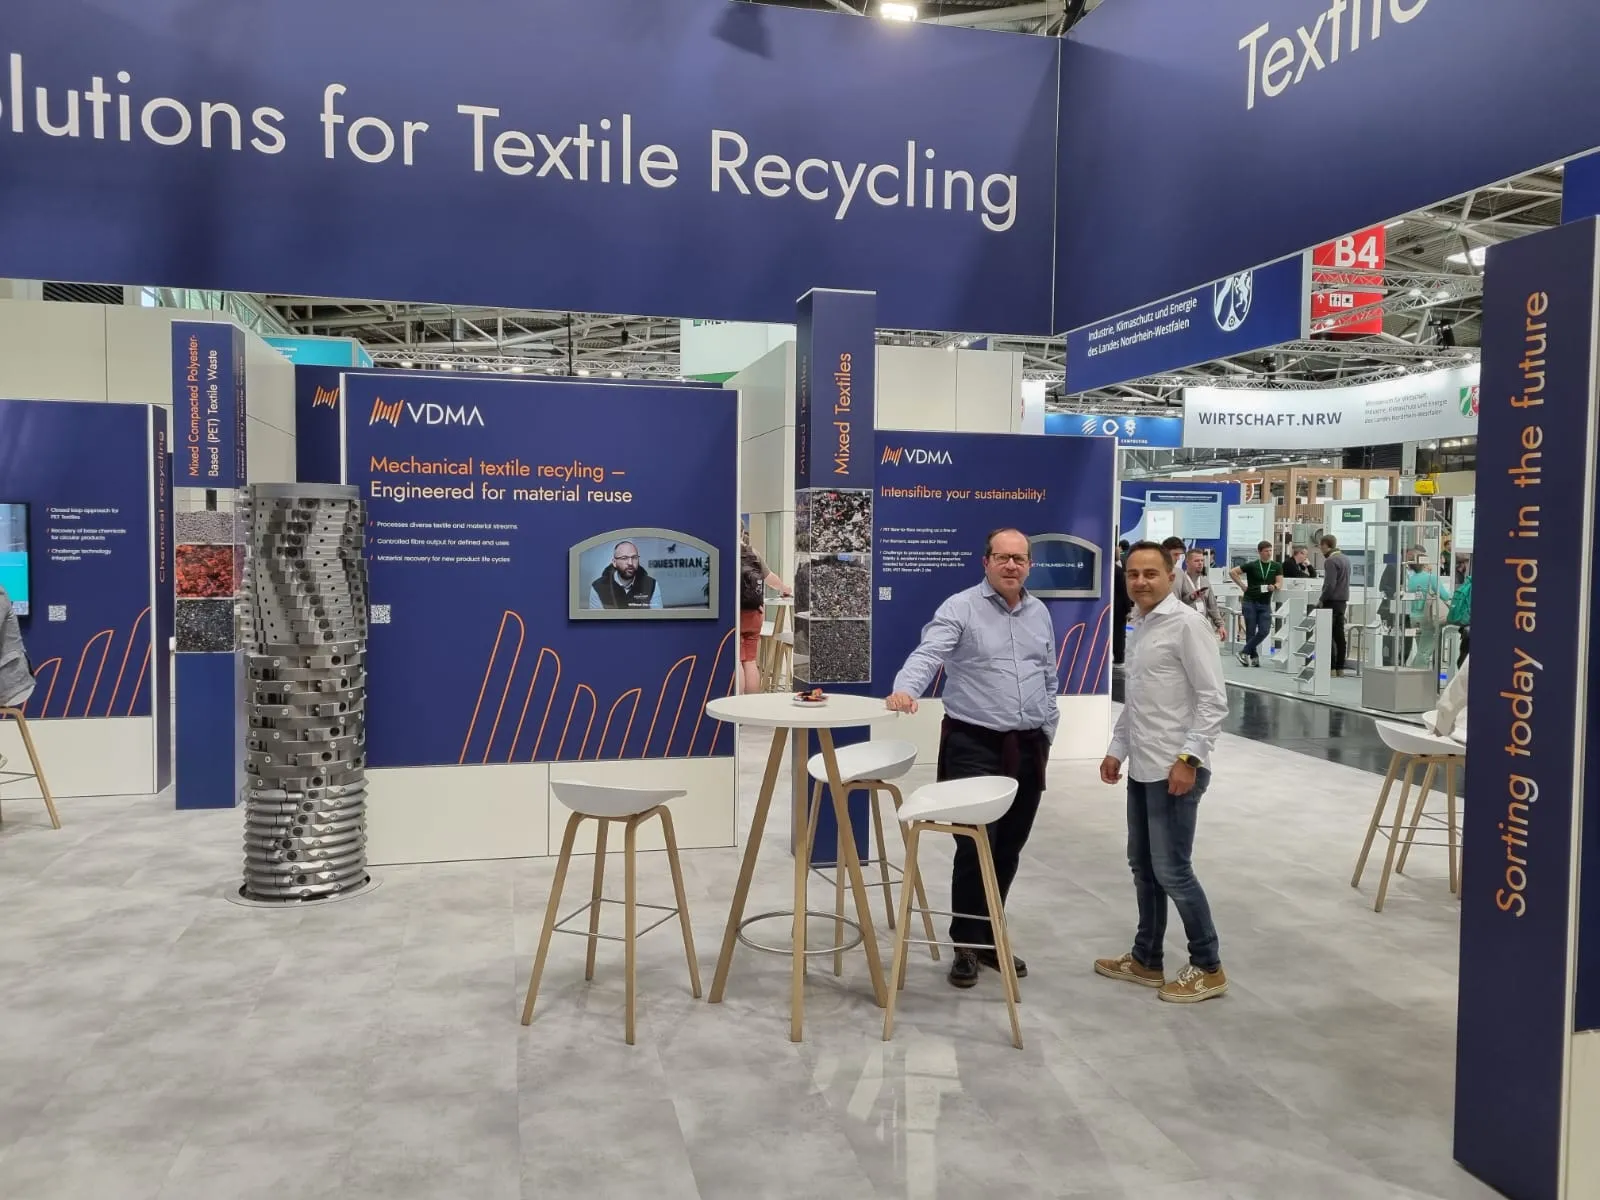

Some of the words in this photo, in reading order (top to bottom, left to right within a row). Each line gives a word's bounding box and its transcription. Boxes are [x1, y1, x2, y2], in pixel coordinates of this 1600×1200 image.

[0, 53, 286, 154] lutions
[320, 83, 428, 166] for
[457, 104, 679, 188] Textile
[710, 129, 1018, 232] Recycling
[1334, 235, 1380, 269] B4
[1088, 325, 1115, 342] Industrie,
[1116, 311, 1154, 332] Klimaschutz
[1154, 307, 1169, 320] und
[1169, 297, 1197, 315] Energie
[1087, 343, 1098, 357] des
[1098, 339, 1120, 355] Landes
[1120, 318, 1190, 347] Nordrhein-Westfalen
[1510, 291, 1549, 408] future
[187, 334, 200, 382] Polyester-
[207, 350, 218, 380] Waste
[207, 384, 218, 415] Textile
[834, 352, 852, 414] Textiles
[187, 385, 201, 442] Compacted
[407, 402, 485, 427] VDMA
[1198, 411, 1343, 427] WIRTSCHAFT.NRW
[207, 418, 221, 443] (PET)
[189, 446, 200, 476] Mixed
[208, 447, 219, 477] Based
[833, 421, 850, 475] Mixed
[905, 448, 953, 465] VDMA
[1508, 425, 1543, 488] the
[157, 431, 165, 502] recycling
[370, 456, 473, 476] Mechanical
[480, 458, 531, 477] textile
[537, 460, 604, 483] recyling
[371, 480, 474, 502] Engineered
[481, 482, 506, 500] for
[513, 484, 580, 502] material
[587, 490, 633, 502] reuse
[881, 485, 942, 499] Intensifibre
[946, 489, 970, 502] your
[974, 487, 1046, 503] sustainability!
[1508, 504, 1540, 537] in
[448, 538, 456, 546] for
[648, 557, 702, 569] EQUESTRIAN
[1504, 558, 1539, 633] and
[1499, 647, 1544, 757] today
[1495, 774, 1539, 918] Sorting
